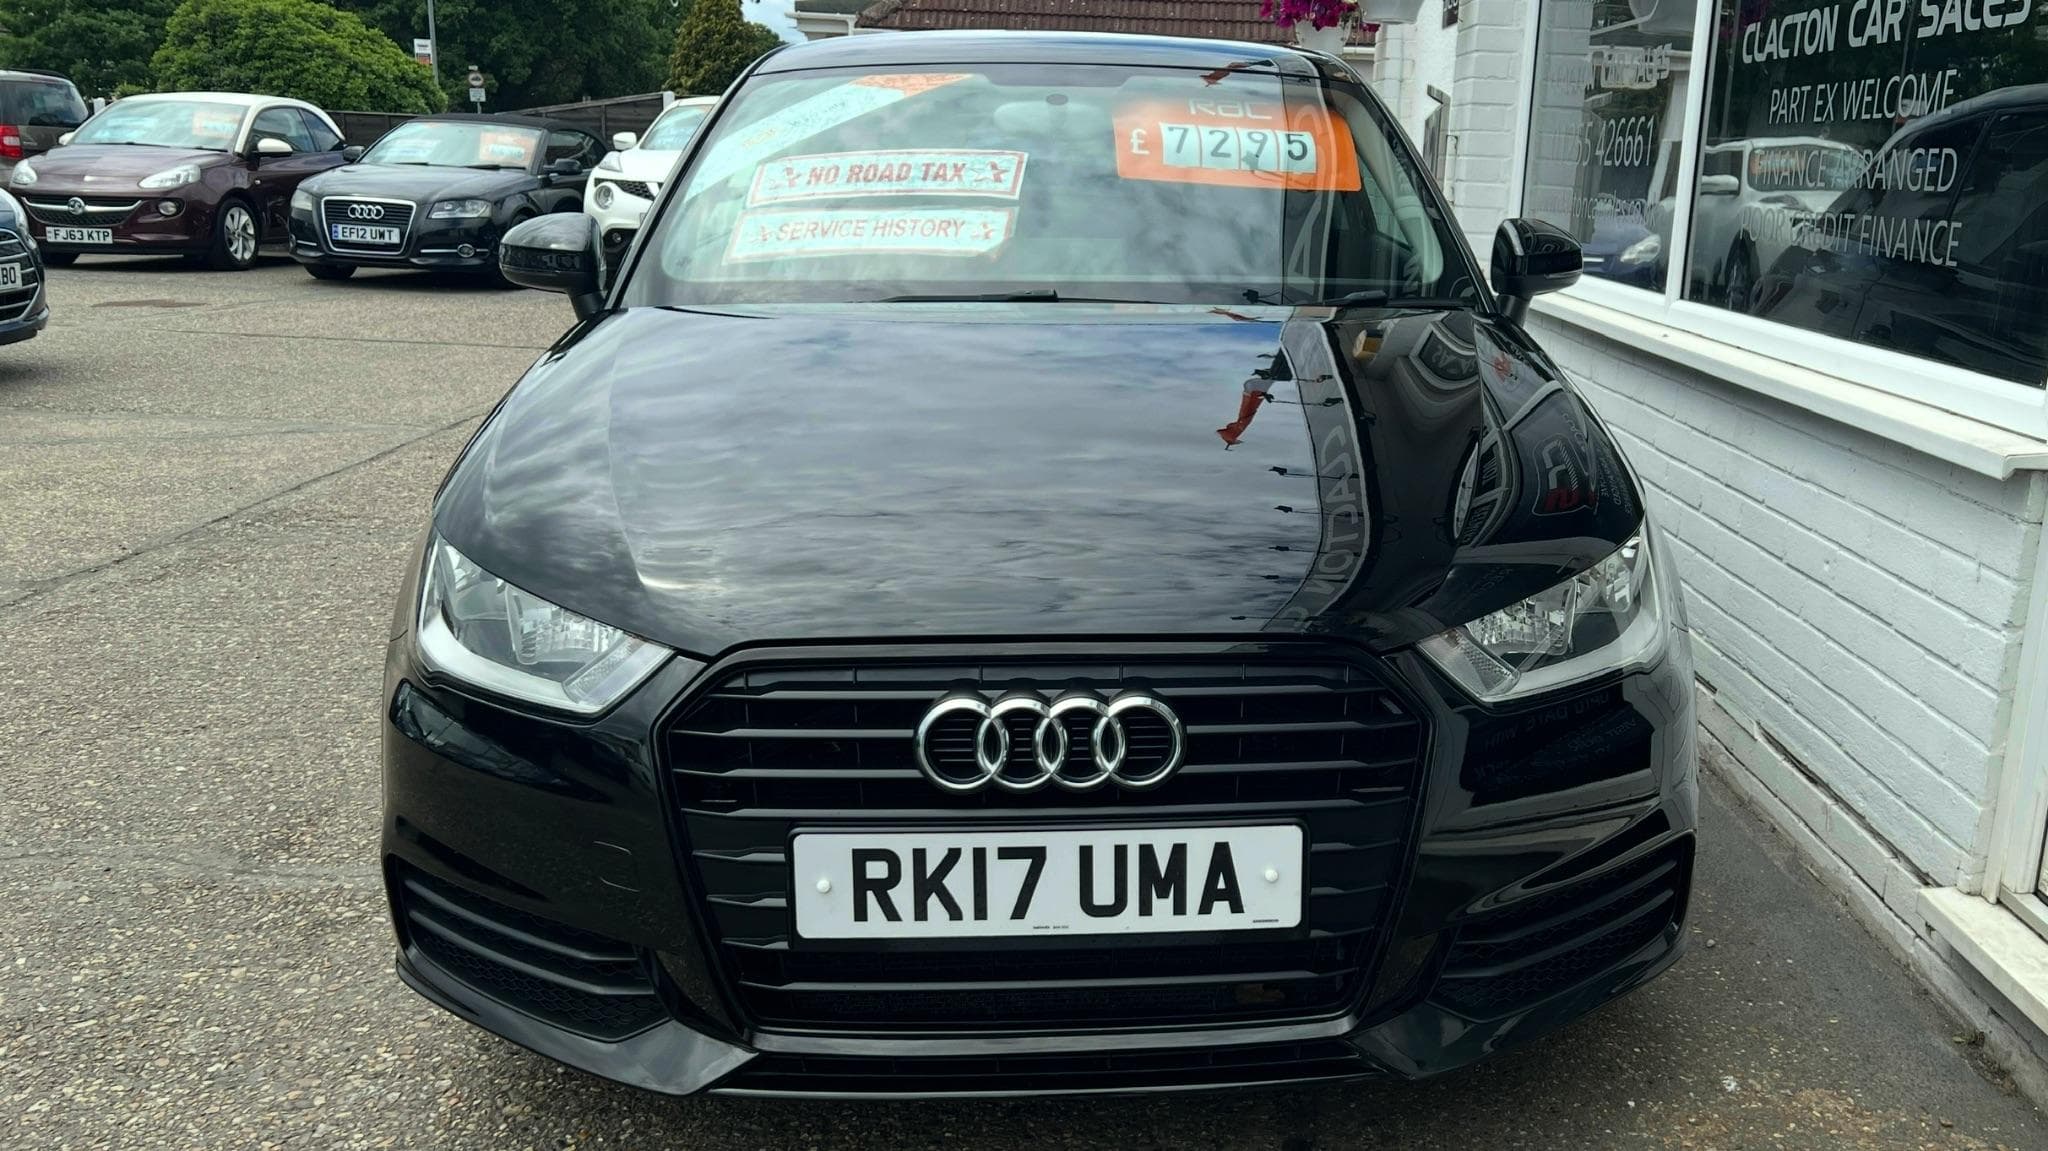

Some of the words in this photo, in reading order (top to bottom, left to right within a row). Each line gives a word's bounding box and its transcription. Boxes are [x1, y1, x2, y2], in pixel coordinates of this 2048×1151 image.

[1742, 4, 1841, 64] CLACTON
[1848, 0, 1905, 48] CAR
[1768, 85, 1811, 125] PART
[1813, 81, 1838, 123] EX
[1843, 69, 1958, 121] WELCOME
[1129, 128, 1150, 155] £
[1167, 126, 1308, 161] 7295
[1595, 115, 1655, 167] 426661
[806, 166, 841, 186] NO
[847, 162, 912, 184] ROAD
[921, 162, 967, 183] TAX
[1755, 150, 1827, 188] FINANCE
[1831, 147, 1958, 192] ARRANGED
[53, 228, 84, 241] FJ63
[87, 229, 110, 241] KTP
[341, 227, 367, 239] EF12
[370, 228, 394, 241] UWT
[776, 219, 868, 241] SERVICE
[872, 218, 967, 239] HISTORY
[1859, 214, 1963, 267] FINANCE
[851, 845, 1048, 923] RK17
[1078, 841, 1246, 919] UMA
